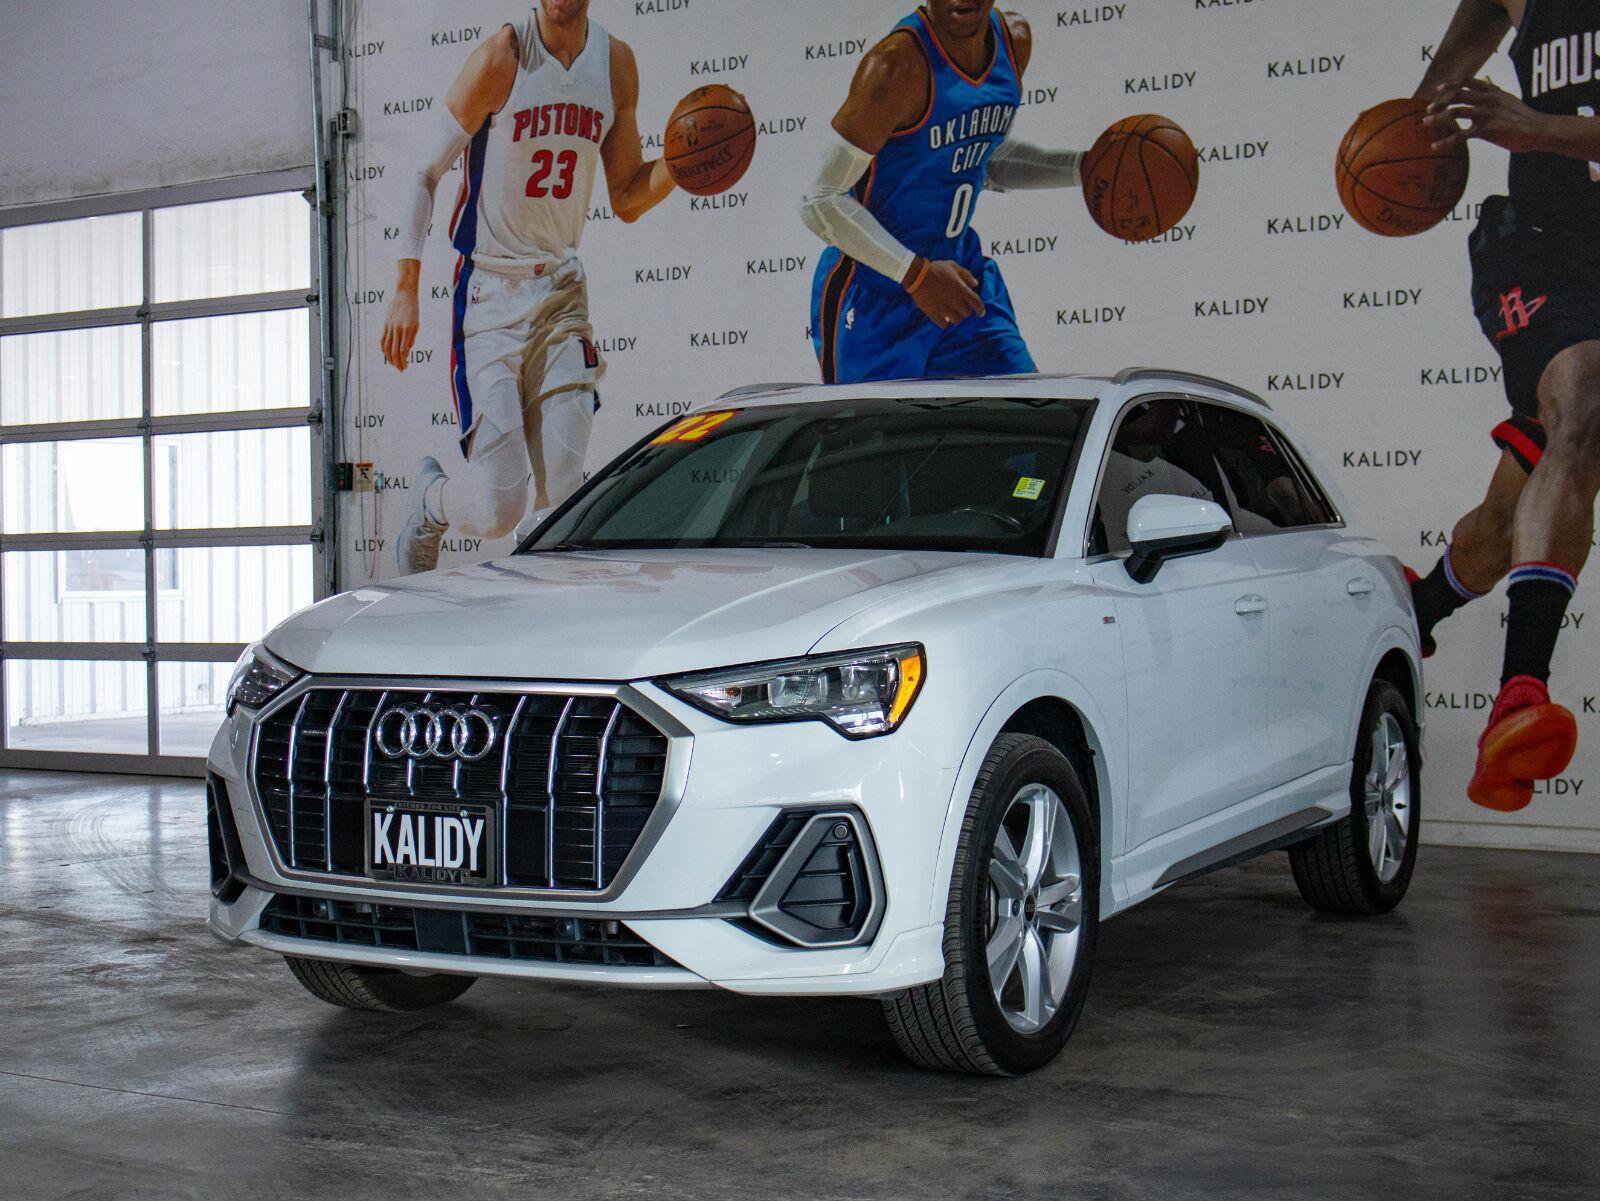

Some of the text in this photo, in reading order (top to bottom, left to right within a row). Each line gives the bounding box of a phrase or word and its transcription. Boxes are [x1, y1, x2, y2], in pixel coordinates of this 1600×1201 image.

[636, 0, 690, 15] KALIDY
[1057, 4, 1126, 27] KALIDY
[432, 27, 482, 46] KALIDY
[805, 39, 867, 60] KALIDY
[691, 55, 749, 75] KALIDY
[1268, 55, 1345, 78] KALIDY
[1532, 30, 1600, 98] HOU
[1125, 71, 1196, 94] KALIDY
[1020, 87, 1058, 105] IDY
[384, 97, 433, 116] KALIDY
[513, 102, 604, 144] PISTONS
[758, 117, 807, 136] ALIDY
[930, 105, 1013, 149] OKLAHOM
[951, 142, 990, 173] CITY
[1198, 141, 1269, 163] KALIDY
[349, 166, 385, 181] LIDY
[525, 149, 578, 200] 23
[690, 192, 749, 212] KALIDY
[945, 183, 973, 239] 0
[1268, 214, 1345, 234] KALIDY
[991, 236, 1058, 256] KALIDY
[636, 266, 691, 284] KALIDY
[747, 256, 807, 275] KALIDY
[355, 290, 385, 305] LIDY
[1195, 297, 1269, 317] KALIDY
[1344, 289, 1422, 308] KALIDY
[1057, 306, 1126, 325] KALIDY
[593, 336, 637, 352] ALIDY
[691, 329, 749, 347] KALIDY
[1268, 373, 1345, 391] KALIDY
[1421, 366, 1502, 386] KALIDY
[636, 401, 692, 417] KALIDY
[355, 414, 385, 428] LIDY
[432, 412, 457, 426] KAL
[1343, 450, 1422, 468] KALIDY
[384, 477, 410, 490] KAL
[690, 470, 739, 483] KALID
[355, 539, 385, 552] LIDY
[440, 538, 482, 552] ALIDY
[1532, 779, 1584, 795] LIDY
[374, 812, 484, 871] KALIDY
